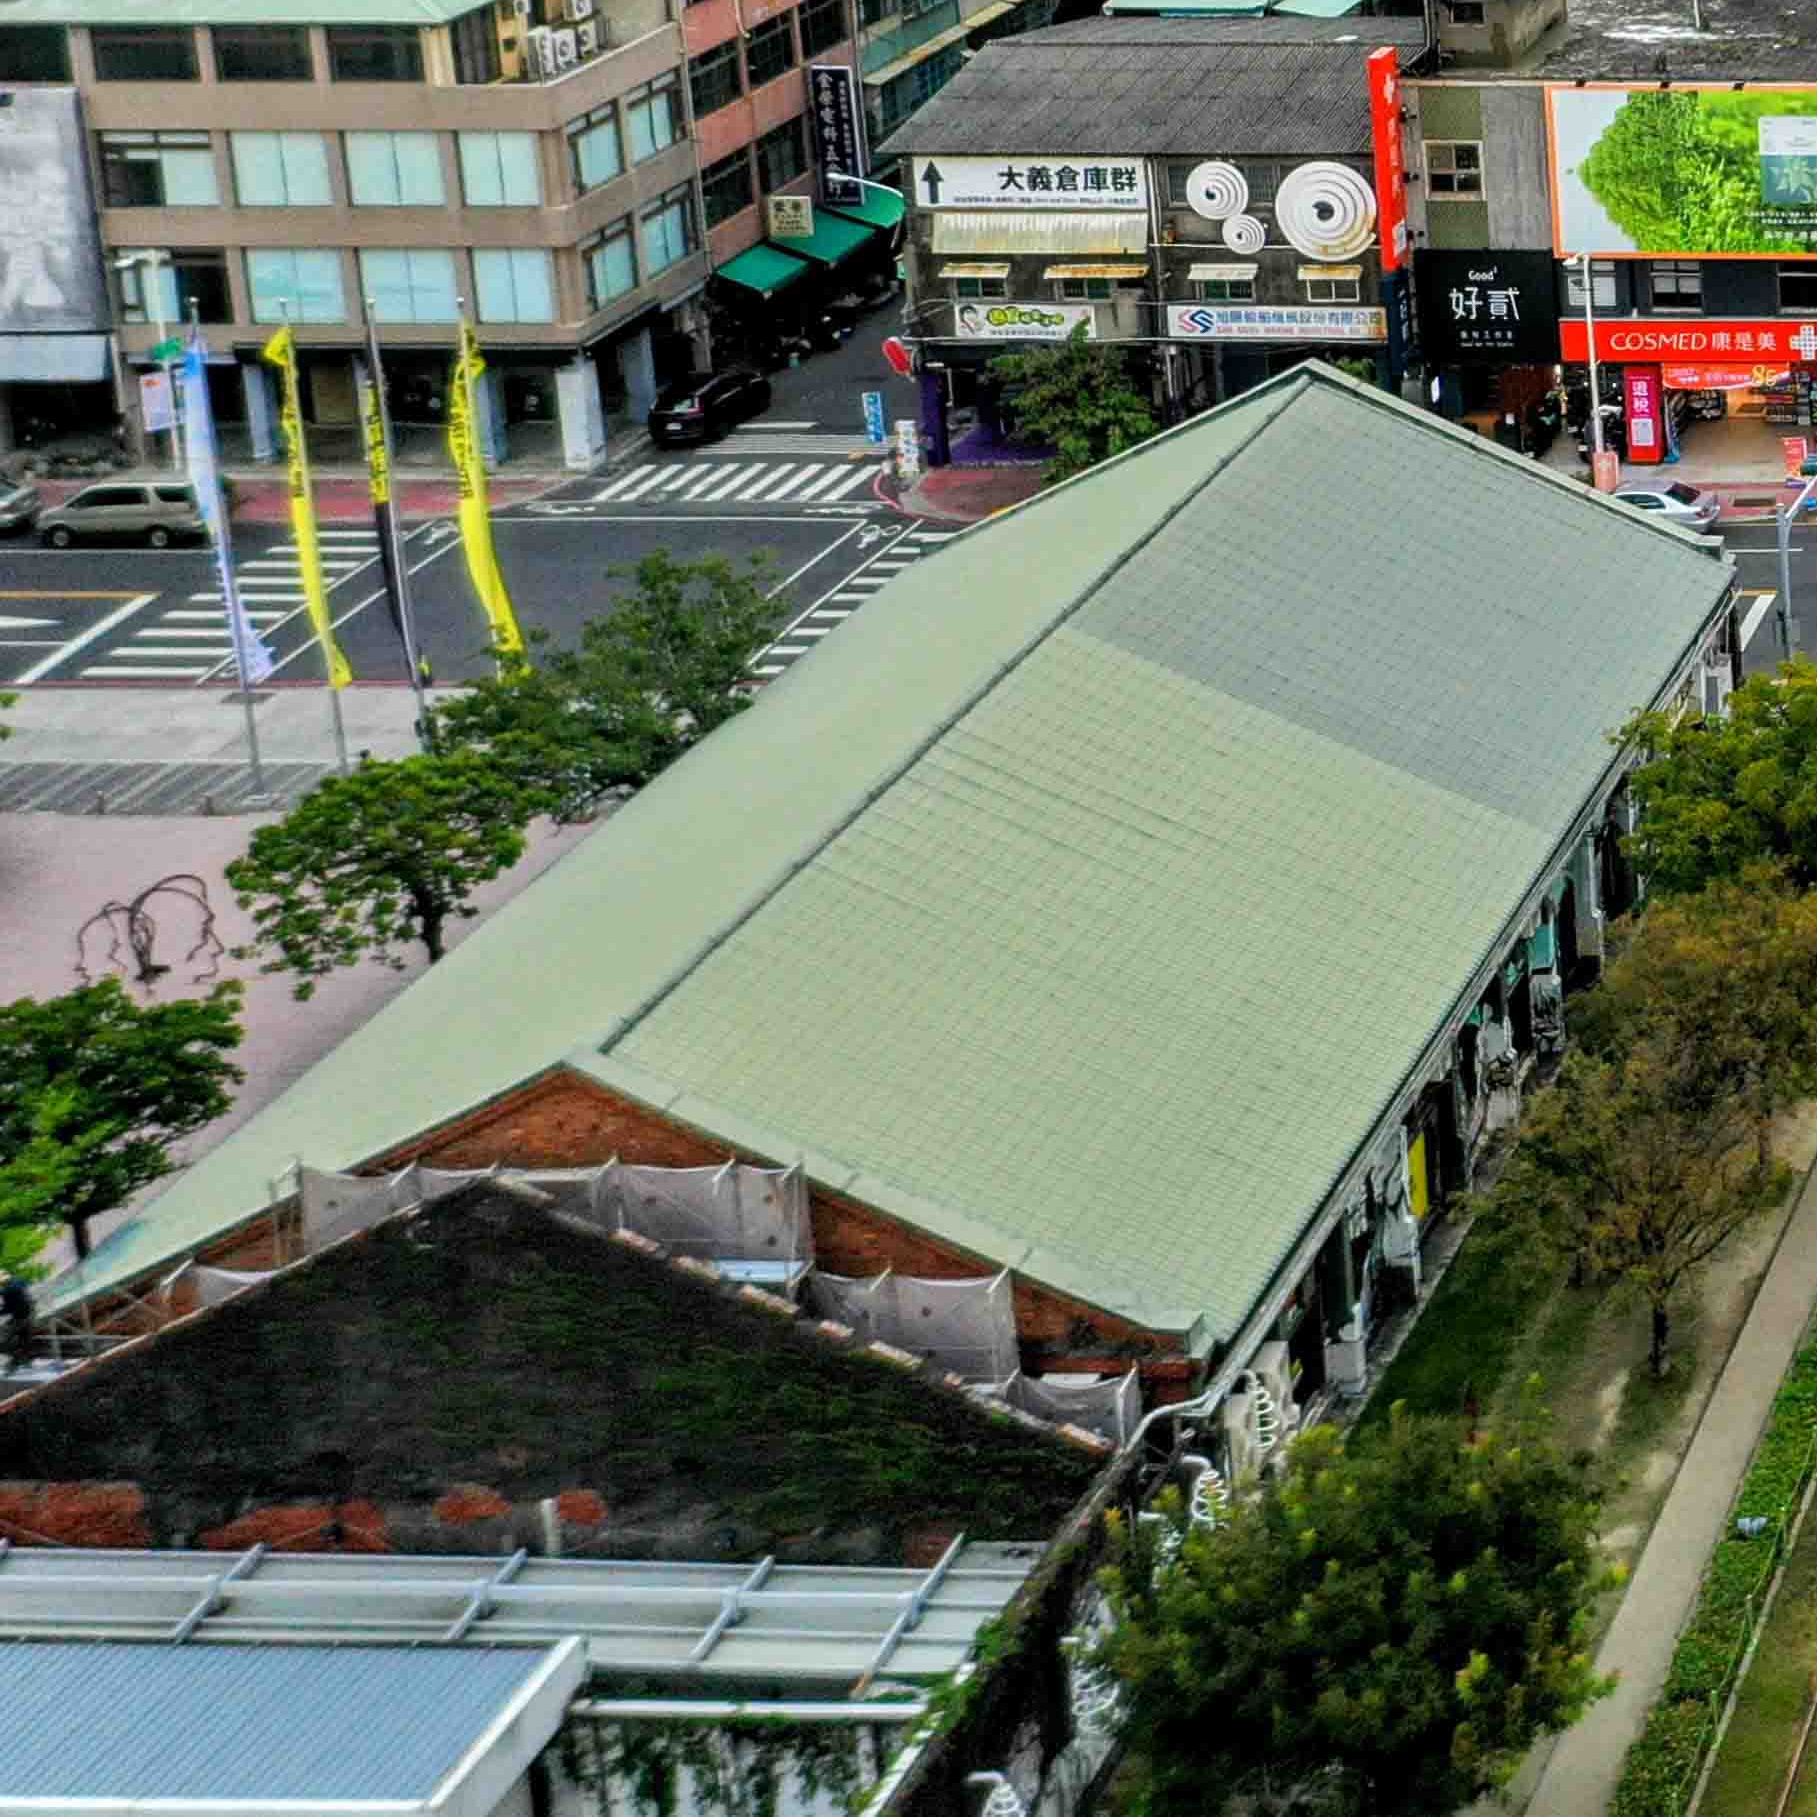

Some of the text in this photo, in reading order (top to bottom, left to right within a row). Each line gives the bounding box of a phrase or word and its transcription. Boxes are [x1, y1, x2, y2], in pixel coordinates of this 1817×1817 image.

[998, 166, 1138, 192] 大義倉庫群
[1610, 331, 1777, 352] COSMED 康是美
